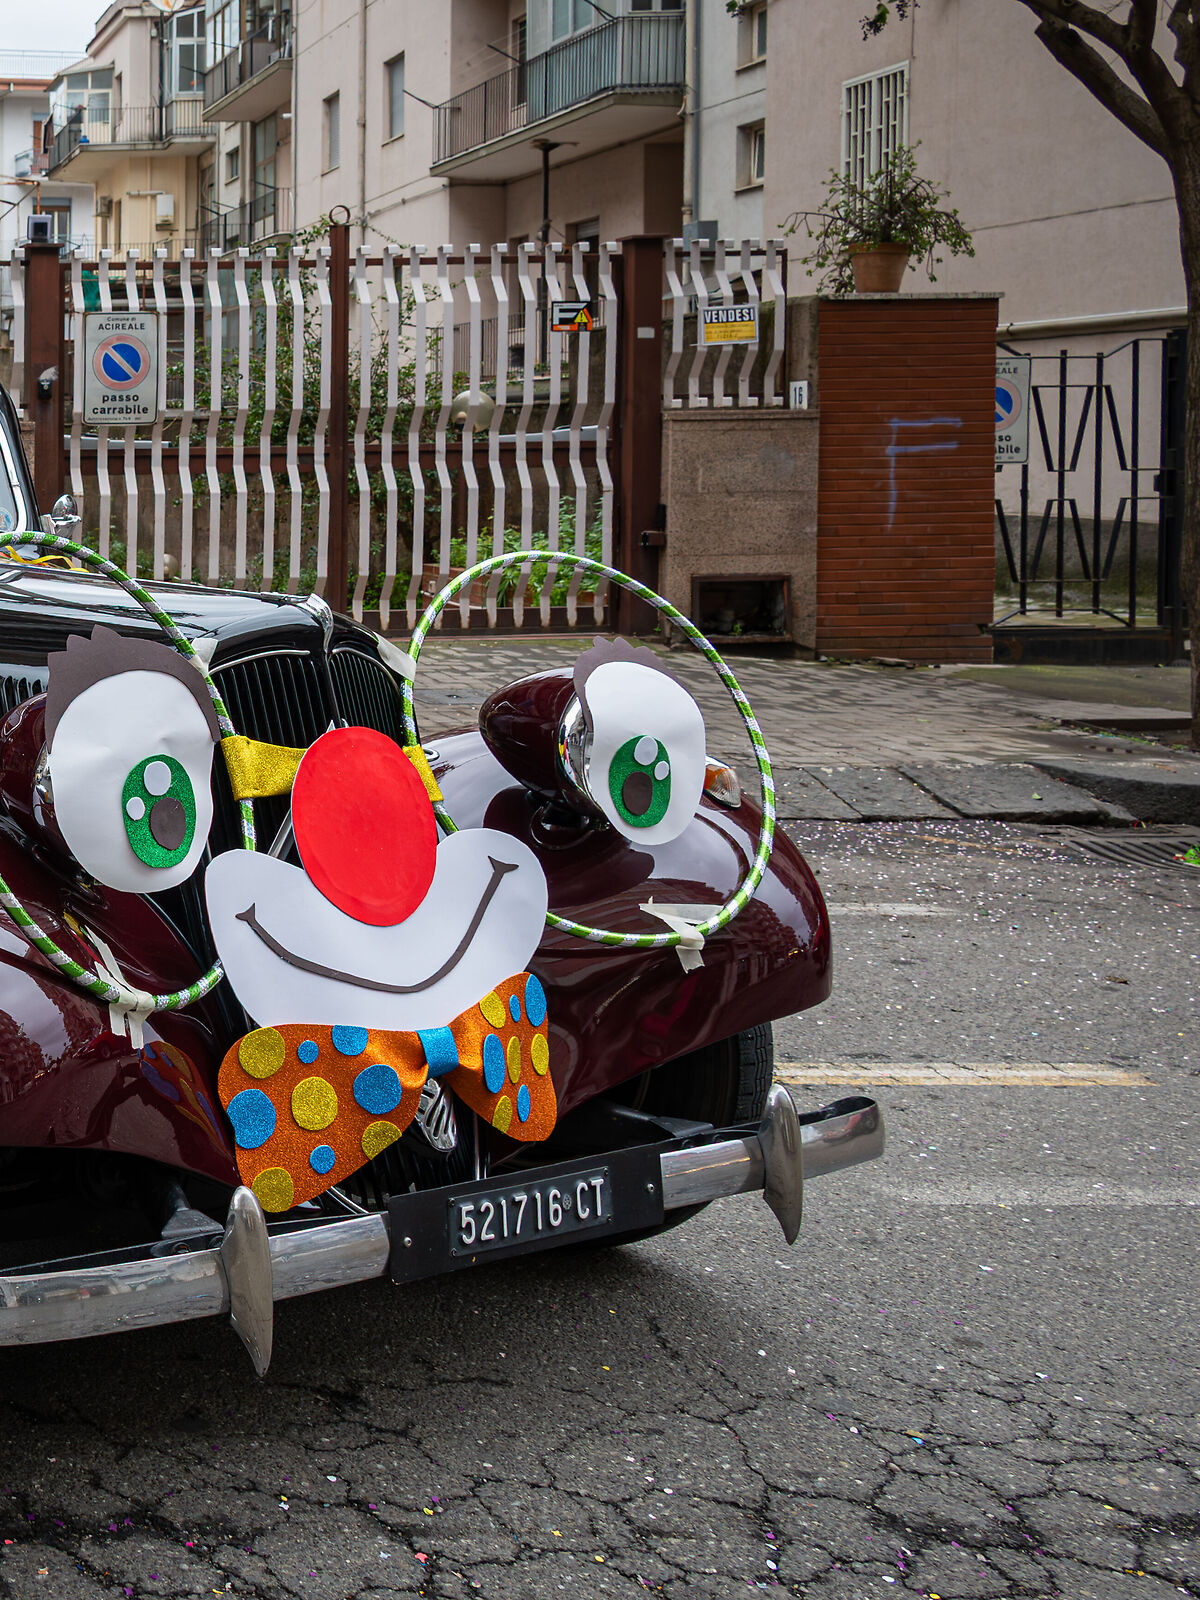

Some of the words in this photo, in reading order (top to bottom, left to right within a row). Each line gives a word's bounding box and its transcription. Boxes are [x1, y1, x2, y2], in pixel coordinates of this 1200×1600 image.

[704, 308, 755, 323] VENDESI
[98, 322, 146, 331] ACIREALE
[102, 394, 140, 404] passo
[793, 386, 803, 405] 16
[92, 404, 149, 415] carrabile
[461, 1189, 563, 1245] 521716
[576, 1178, 605, 1219] CT
